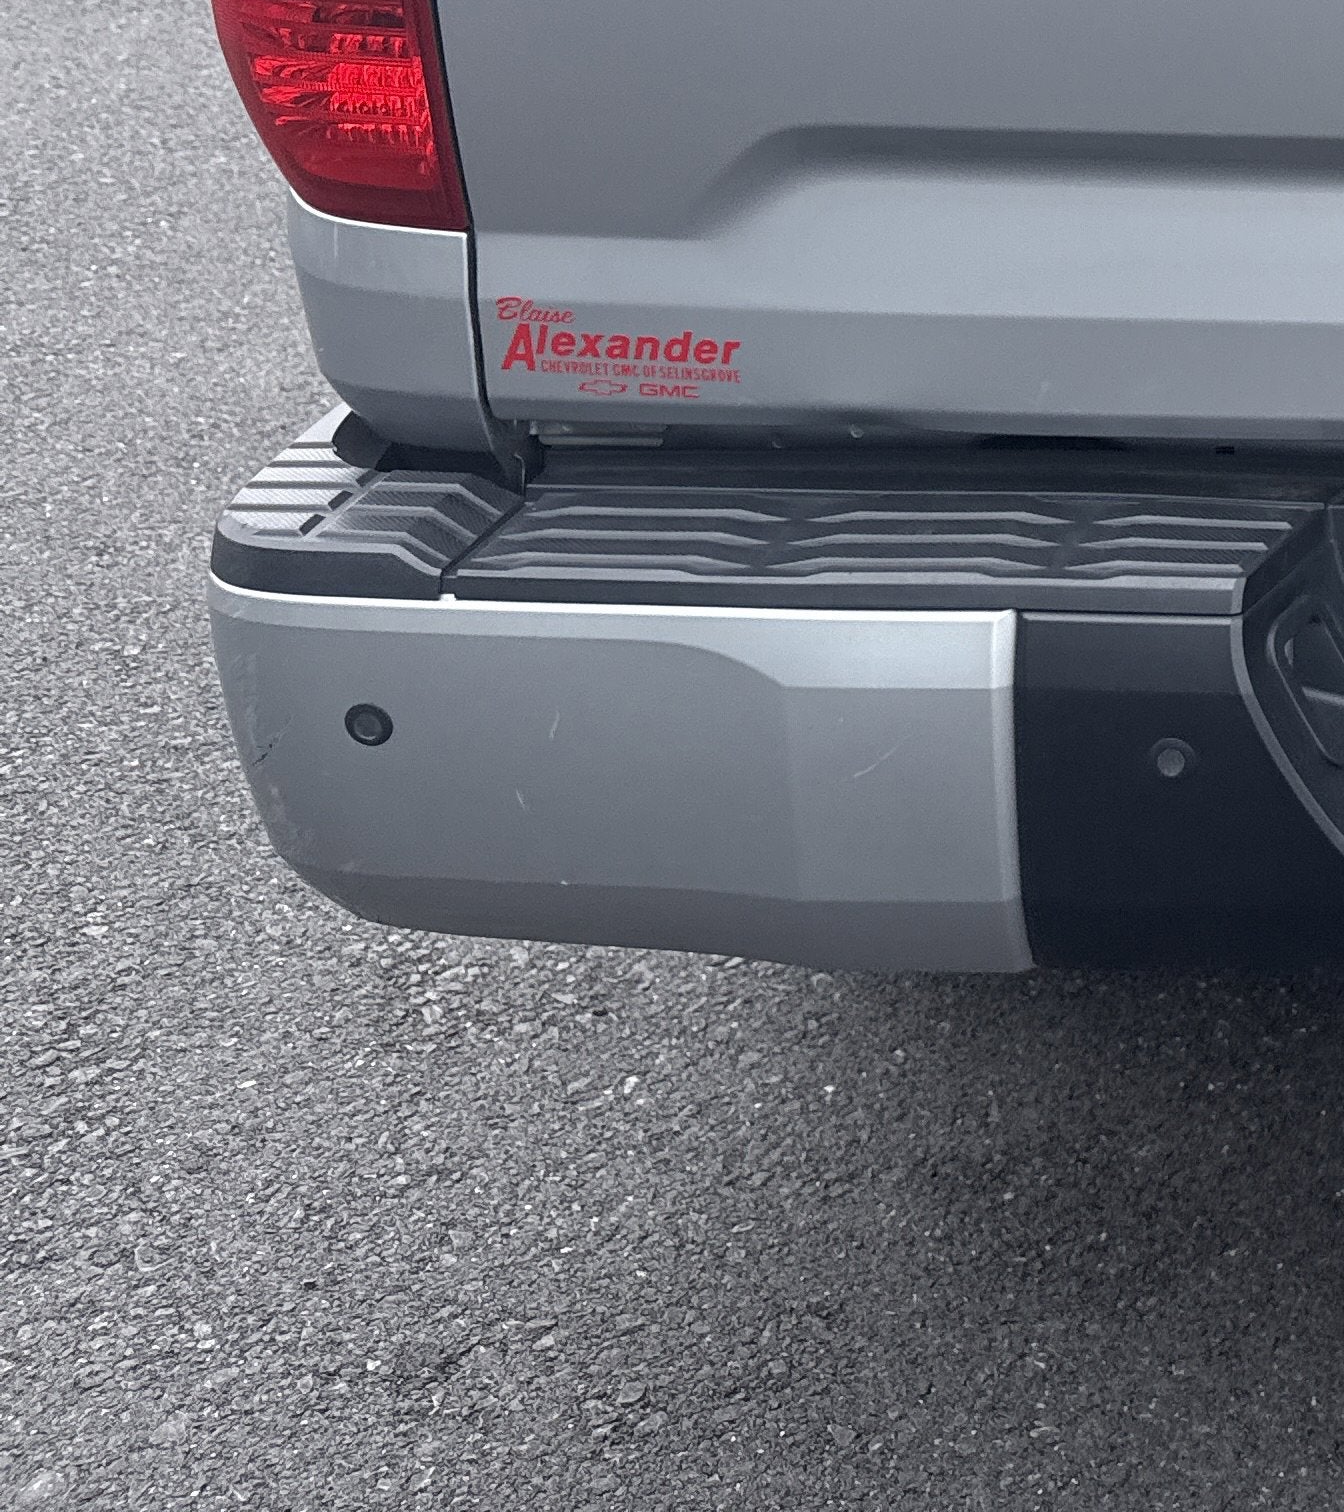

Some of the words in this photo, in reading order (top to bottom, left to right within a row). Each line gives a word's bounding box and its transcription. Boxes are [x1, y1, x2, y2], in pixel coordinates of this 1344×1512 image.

[496, 296, 575, 324] Blaise
[501, 322, 742, 372] Alexander
[541, 359, 609, 376] CHEVROLET
[613, 363, 640, 377] GMC
[643, 365, 657, 377] OF
[639, 383, 700, 398] GMC
